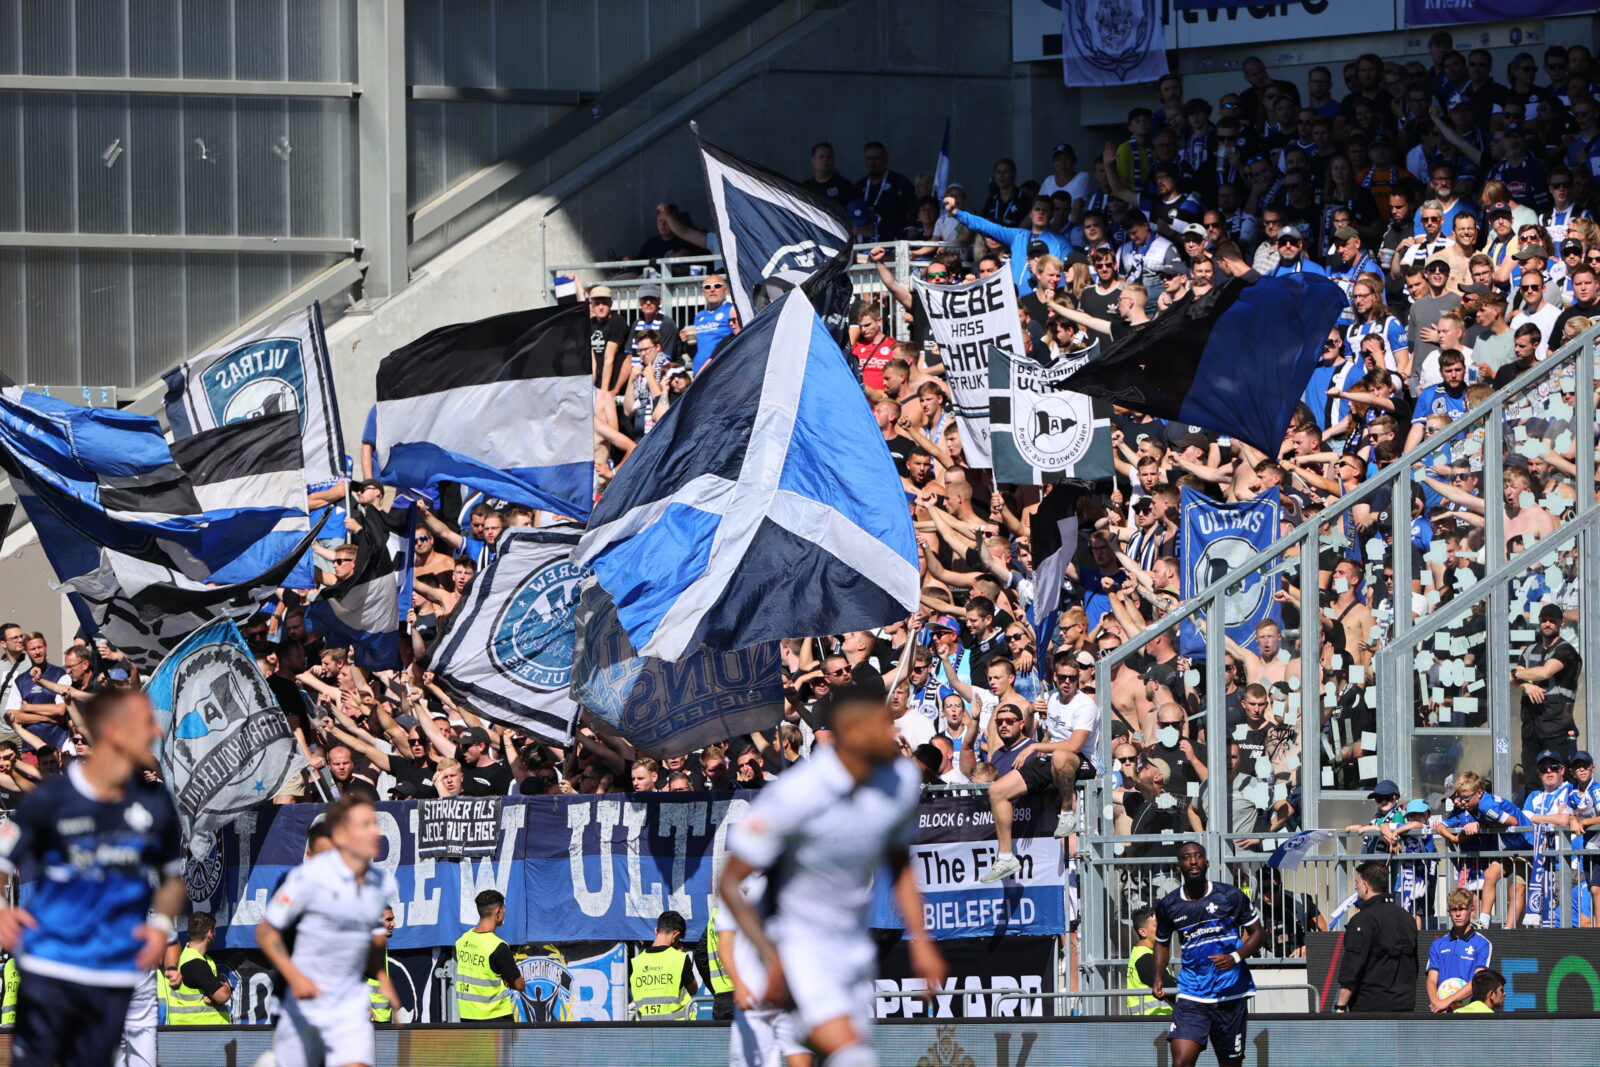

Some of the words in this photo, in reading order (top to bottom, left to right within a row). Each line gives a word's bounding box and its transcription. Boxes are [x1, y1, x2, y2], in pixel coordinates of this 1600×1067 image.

[925, 279, 1004, 319] LIEBE
[951, 320, 984, 337] HASS
[1018, 365, 1038, 377] DSC
[948, 373, 989, 391] STRUK
[1050, 419, 1060, 431] A
[1019, 427, 1033, 452] Power
[1032, 453, 1047, 464] aus
[1048, 423, 1088, 465] Ostwestfalen
[1199, 510, 1265, 535] ULTRAS
[473, 799, 495, 820] ALS
[918, 811, 955, 828] BLOCK
[956, 811, 964, 826] 6
[1012, 807, 1032, 822] 998
[446, 821, 497, 841] AUFLAGE
[917, 851, 966, 885] The
[971, 847, 1034, 883] Fim
[923, 897, 1036, 931] BIELEFELD
[635, 973, 674, 988] ORDNER
[644, 1004, 662, 1015] 157
[1234, 1033, 1242, 1053] 5
